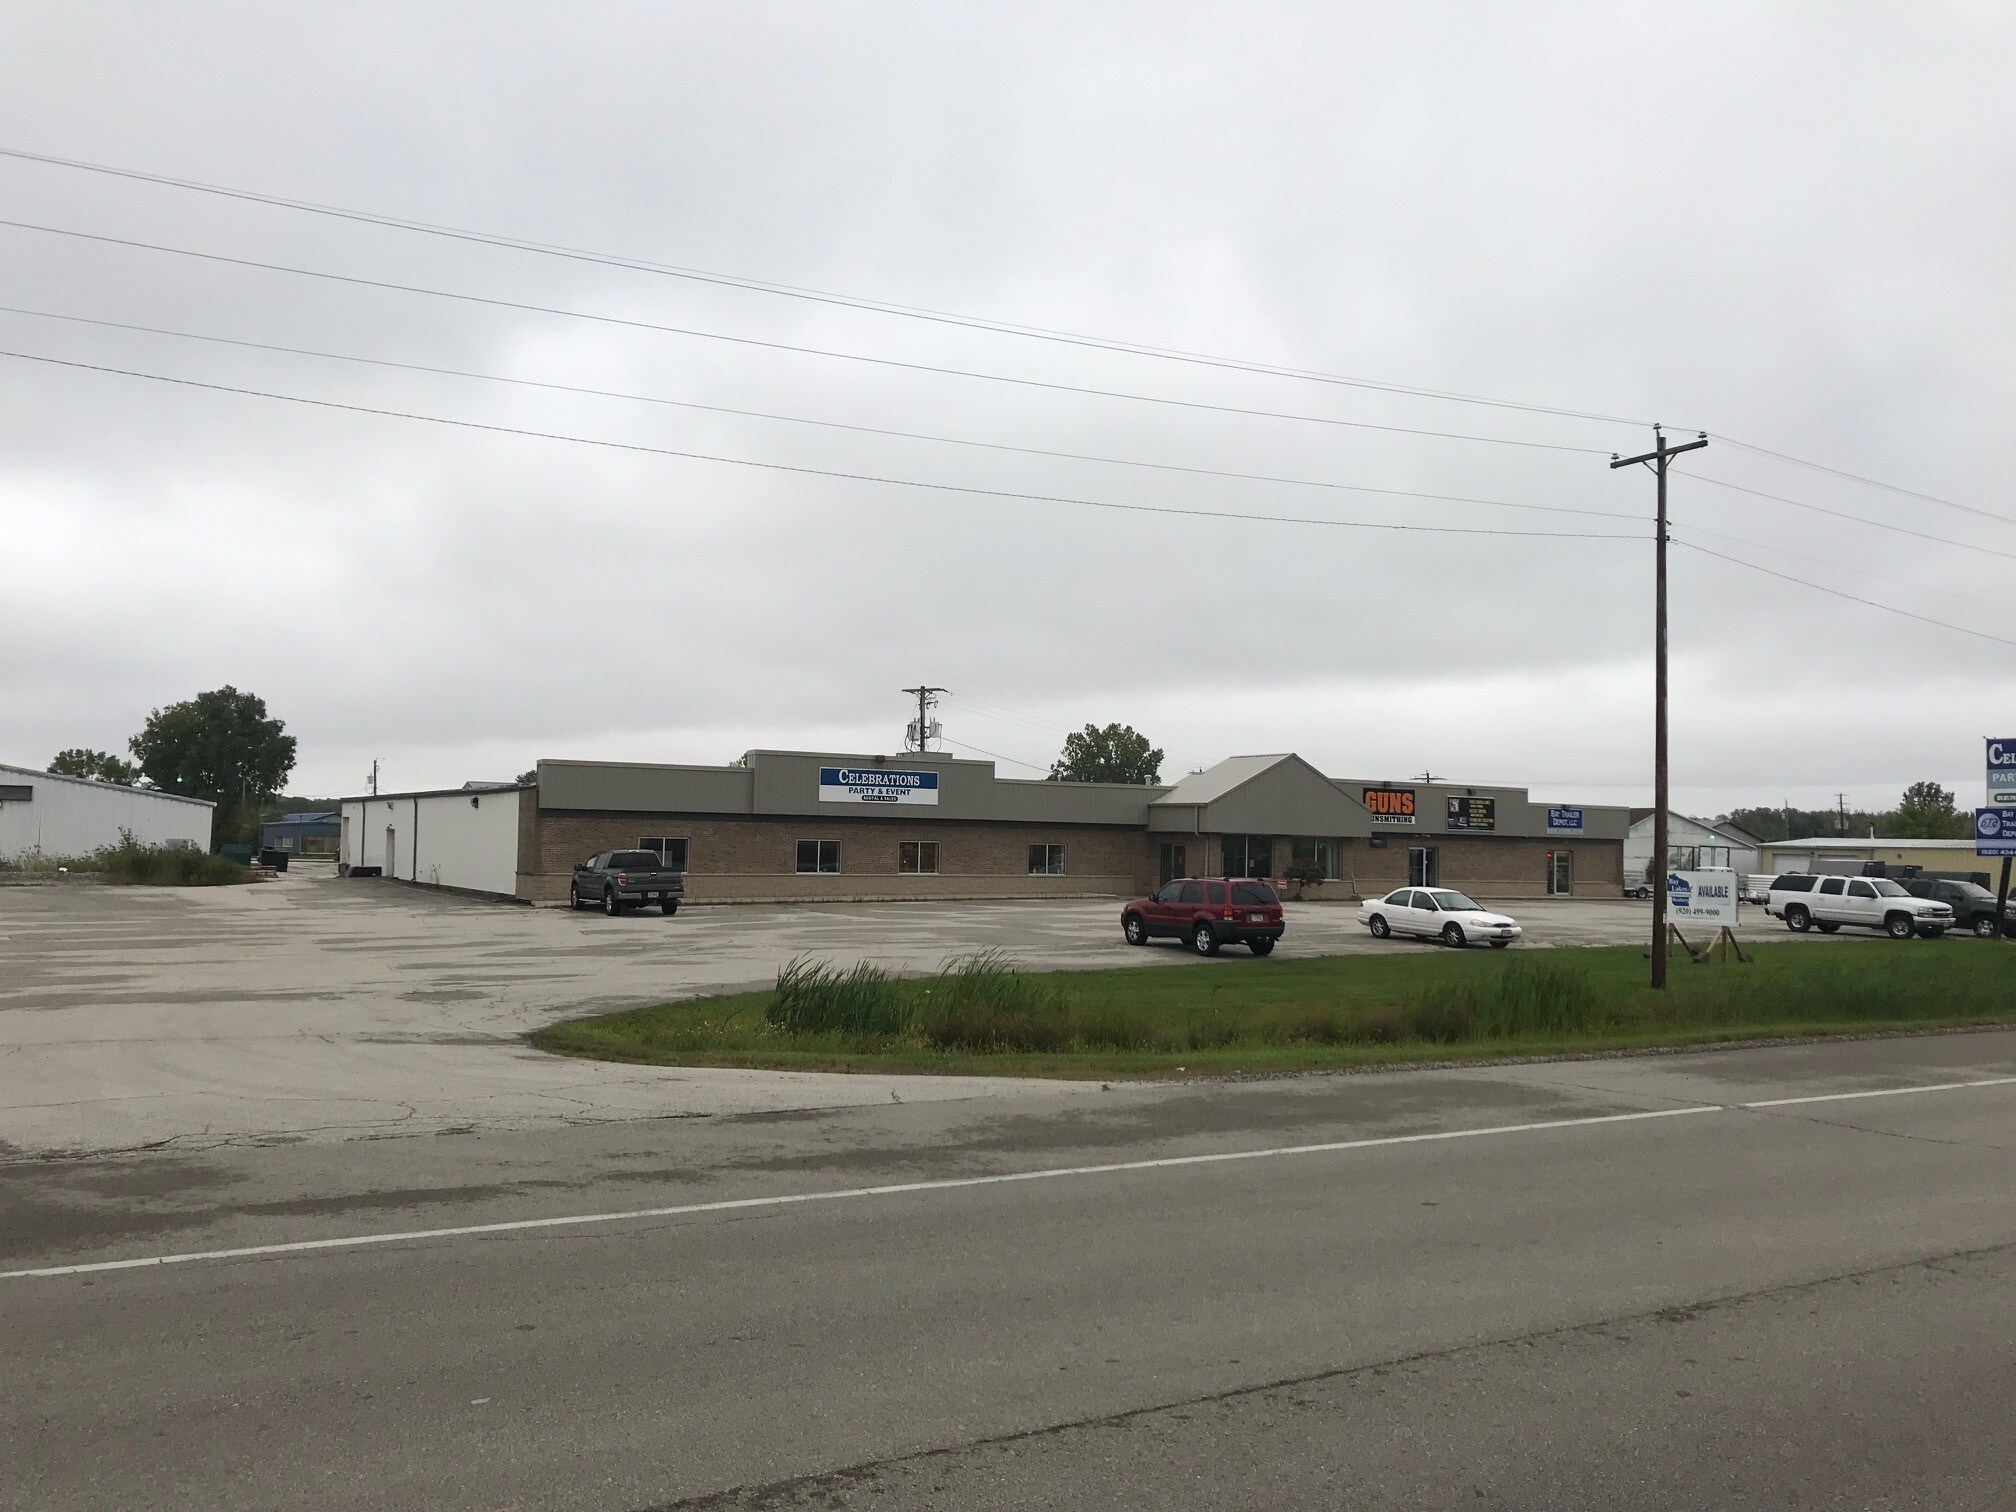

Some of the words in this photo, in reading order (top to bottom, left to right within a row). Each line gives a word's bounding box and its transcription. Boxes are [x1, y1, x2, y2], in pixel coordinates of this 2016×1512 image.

[838, 769, 920, 786] CELEBRATIONS
[848, 787, 876, 795] PARTY
[885, 788, 911, 796] EVENT
[1365, 791, 1414, 814] GUNS
[1550, 809, 1560, 818] BAY
[1561, 810, 1580, 819] TRAILER
[2002, 810, 2014, 818] BAY
[1698, 885, 1729, 898] AVAILABLE
[1675, 907, 1692, 915] (920)
[1693, 908, 1720, 916] 499-9000
